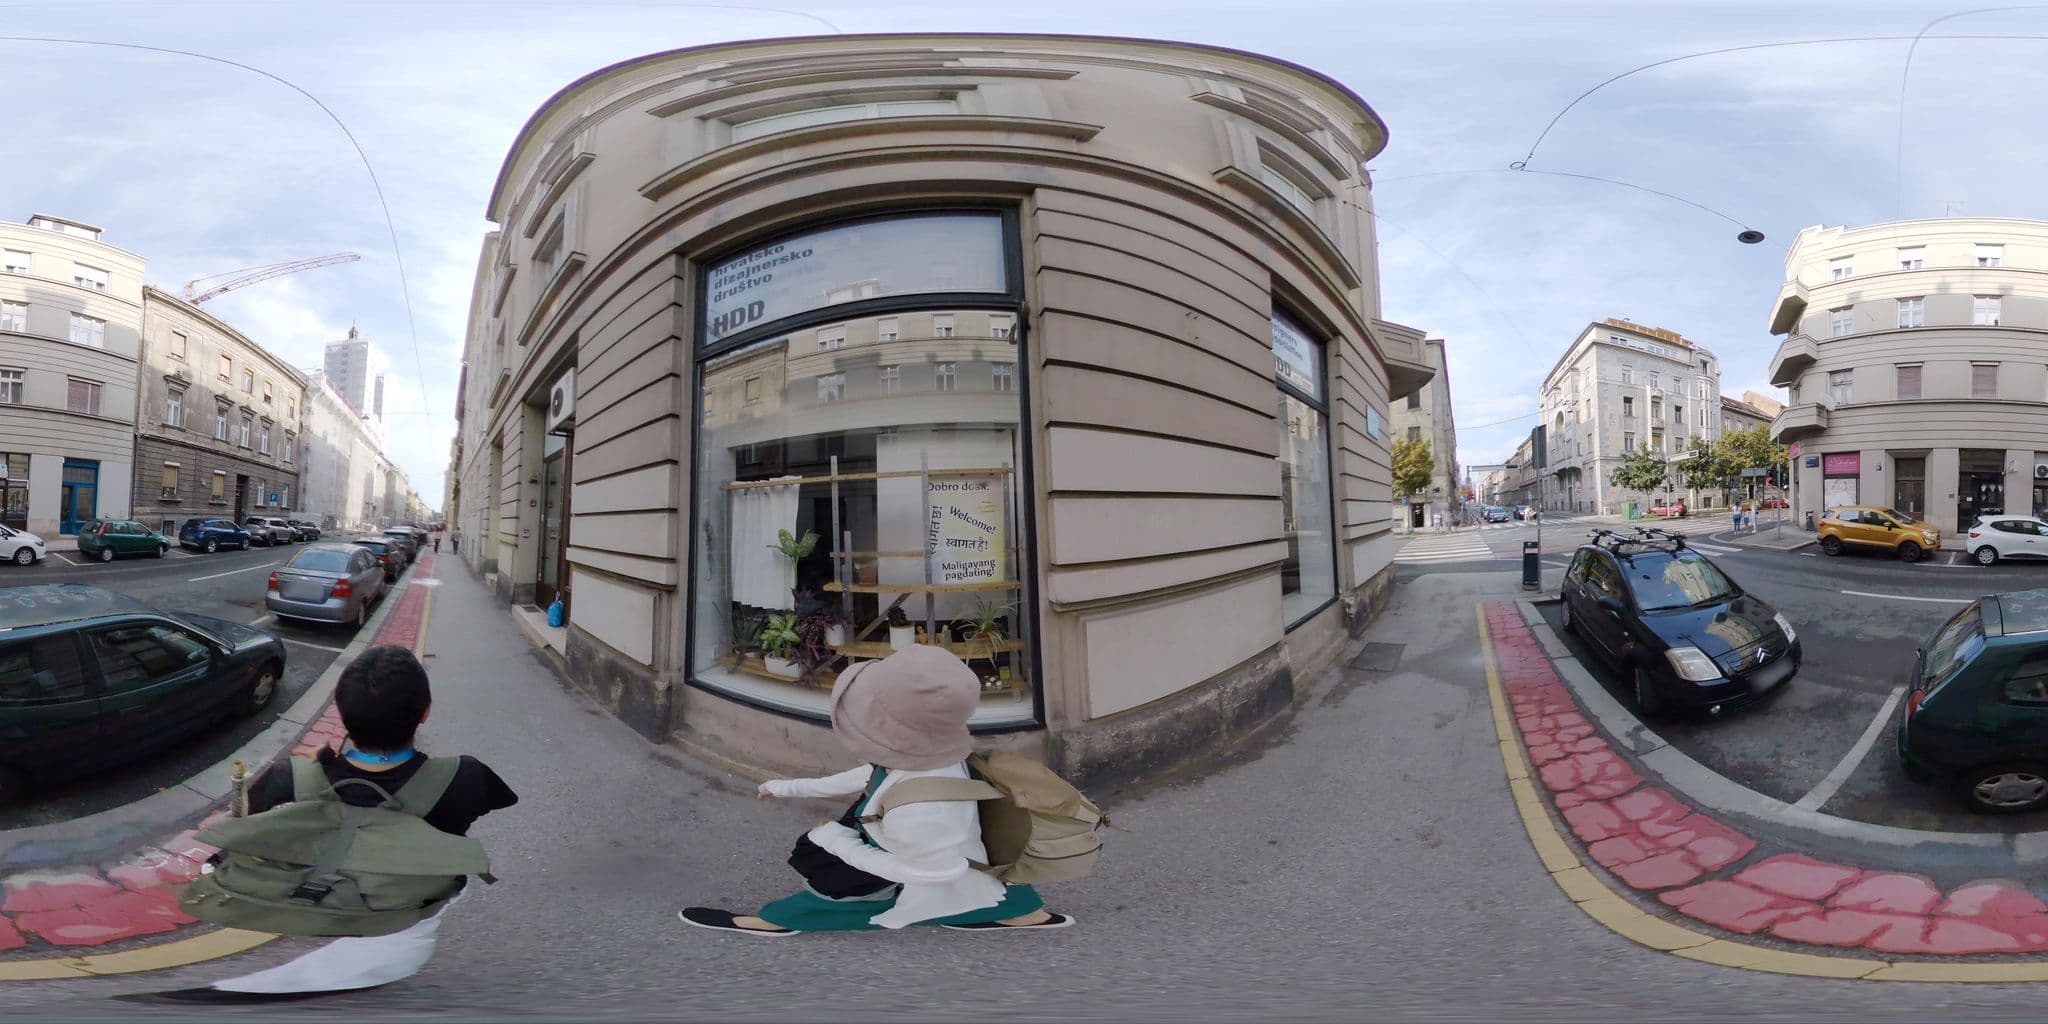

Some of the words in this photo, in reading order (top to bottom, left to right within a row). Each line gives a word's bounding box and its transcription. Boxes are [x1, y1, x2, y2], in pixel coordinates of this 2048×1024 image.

[714, 248, 813, 290] dizajnersko
[715, 244, 785, 277] hrvatsko
[714, 273, 773, 303] društvo
[713, 300, 765, 338] HDD
[928, 481, 959, 492] Dobro
[950, 505, 997, 534] Welcome!
[945, 538, 976, 549] स्वागत
[942, 559, 996, 571] Maligayang
[945, 565, 995, 581] pagdating!
